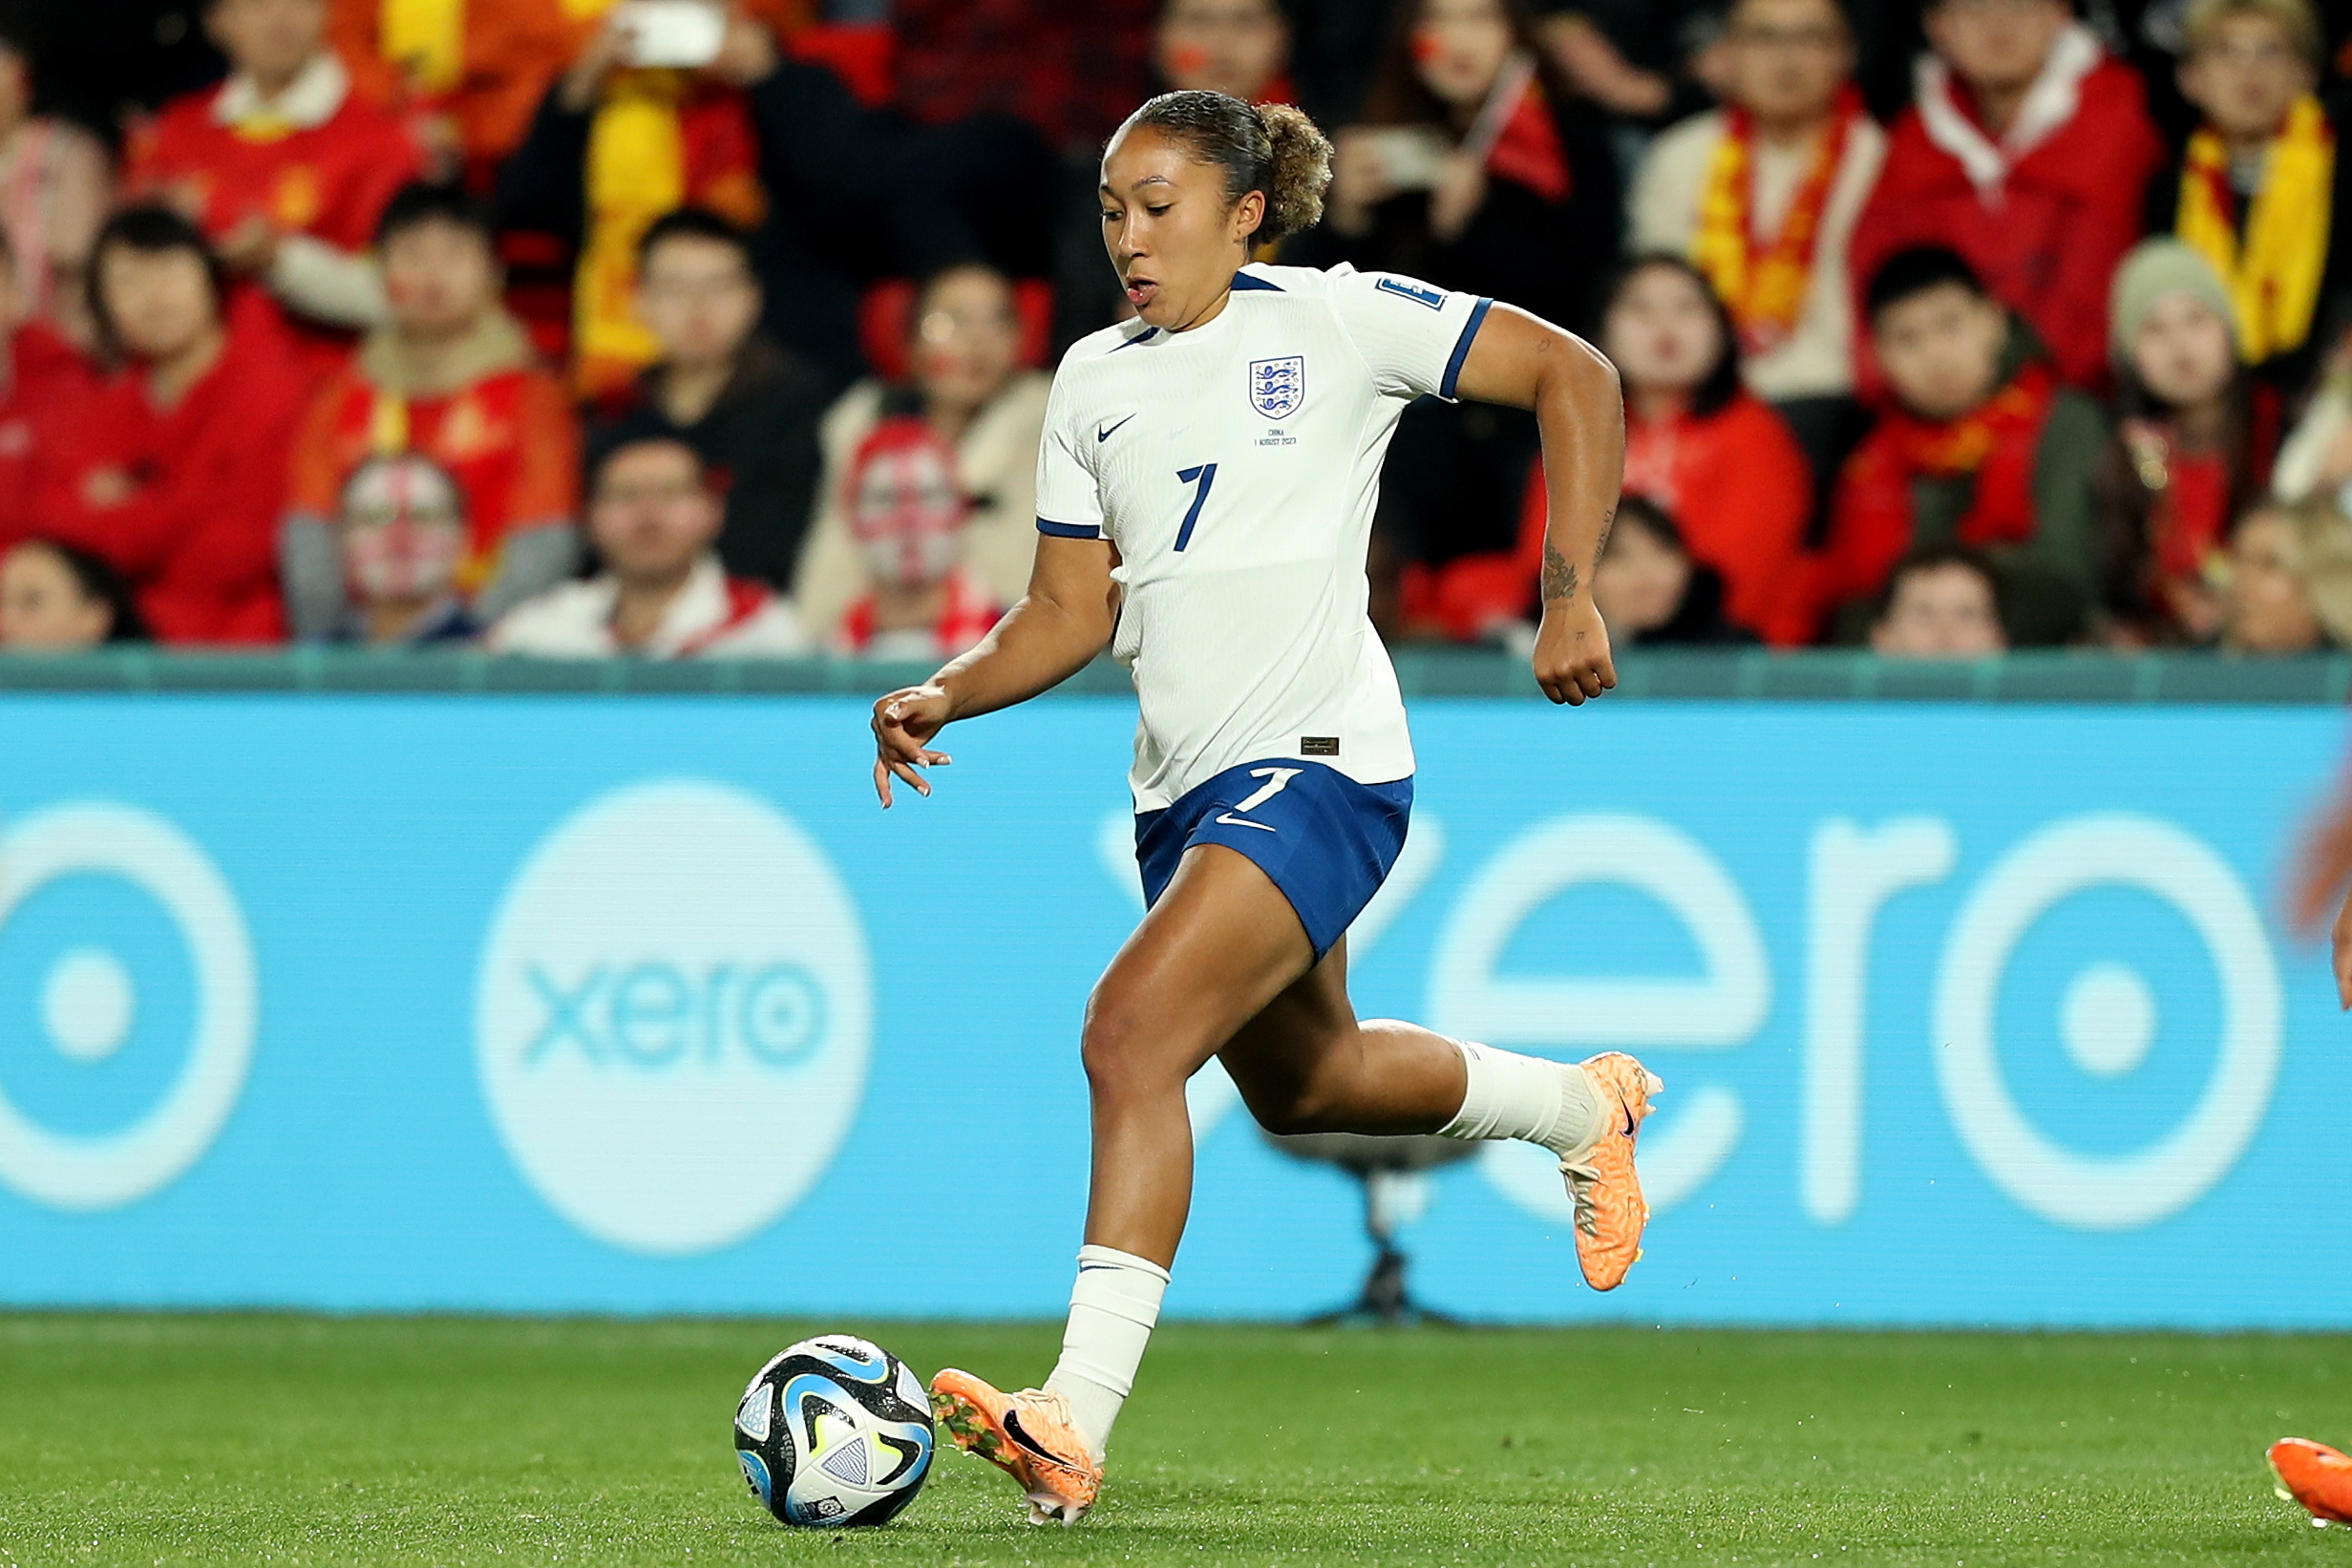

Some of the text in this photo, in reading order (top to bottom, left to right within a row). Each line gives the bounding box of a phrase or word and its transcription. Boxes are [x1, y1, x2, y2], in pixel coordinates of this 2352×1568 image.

[1175, 463, 1218, 552] 7
[1234, 767, 1304, 813] 7
[520, 959, 829, 1070] xero
